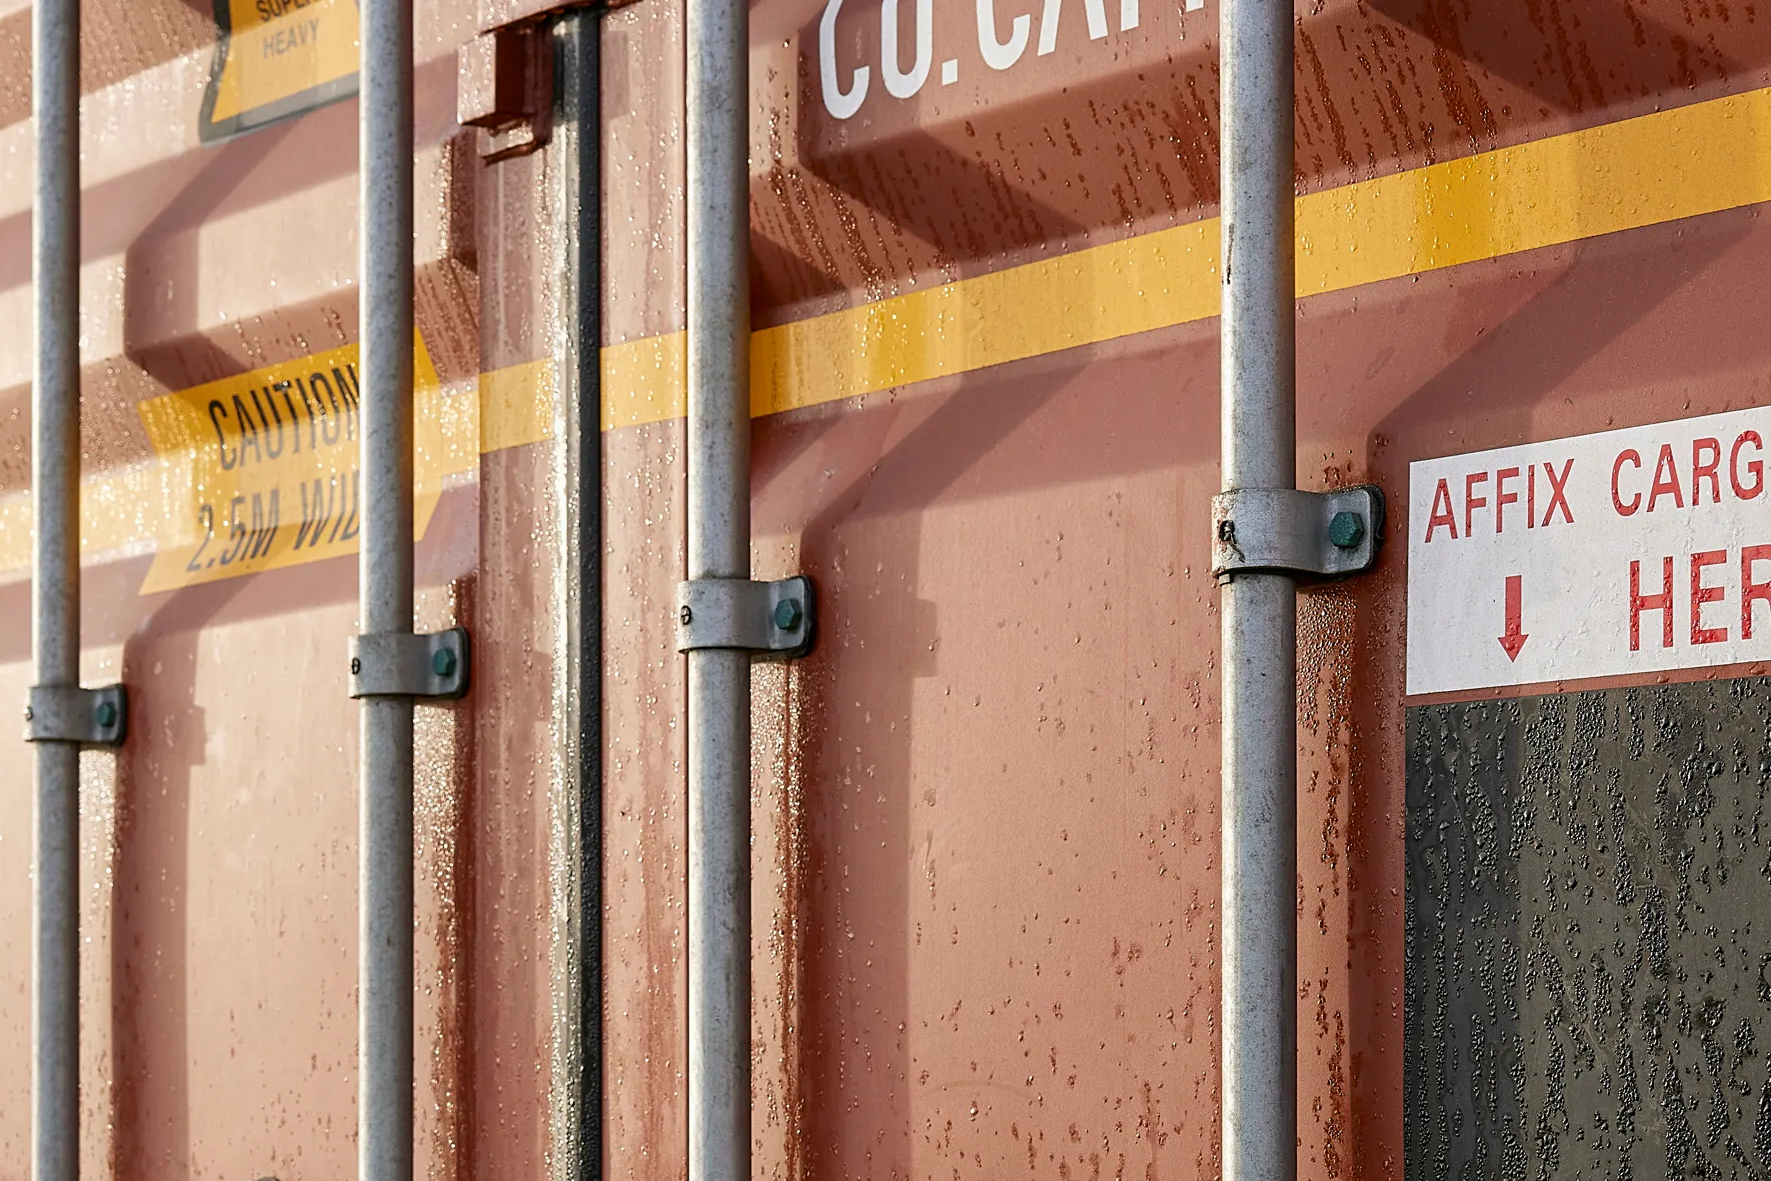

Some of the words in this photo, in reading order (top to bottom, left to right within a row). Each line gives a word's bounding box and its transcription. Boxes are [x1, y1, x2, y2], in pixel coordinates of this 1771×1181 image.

[262, 18, 320, 60] HEAVY
[208, 364, 360, 470] CAUTION
[185, 488, 280, 572] 2.5M
[1424, 458, 1575, 543] AFFIX
[1611, 429, 1770, 517] CARG
